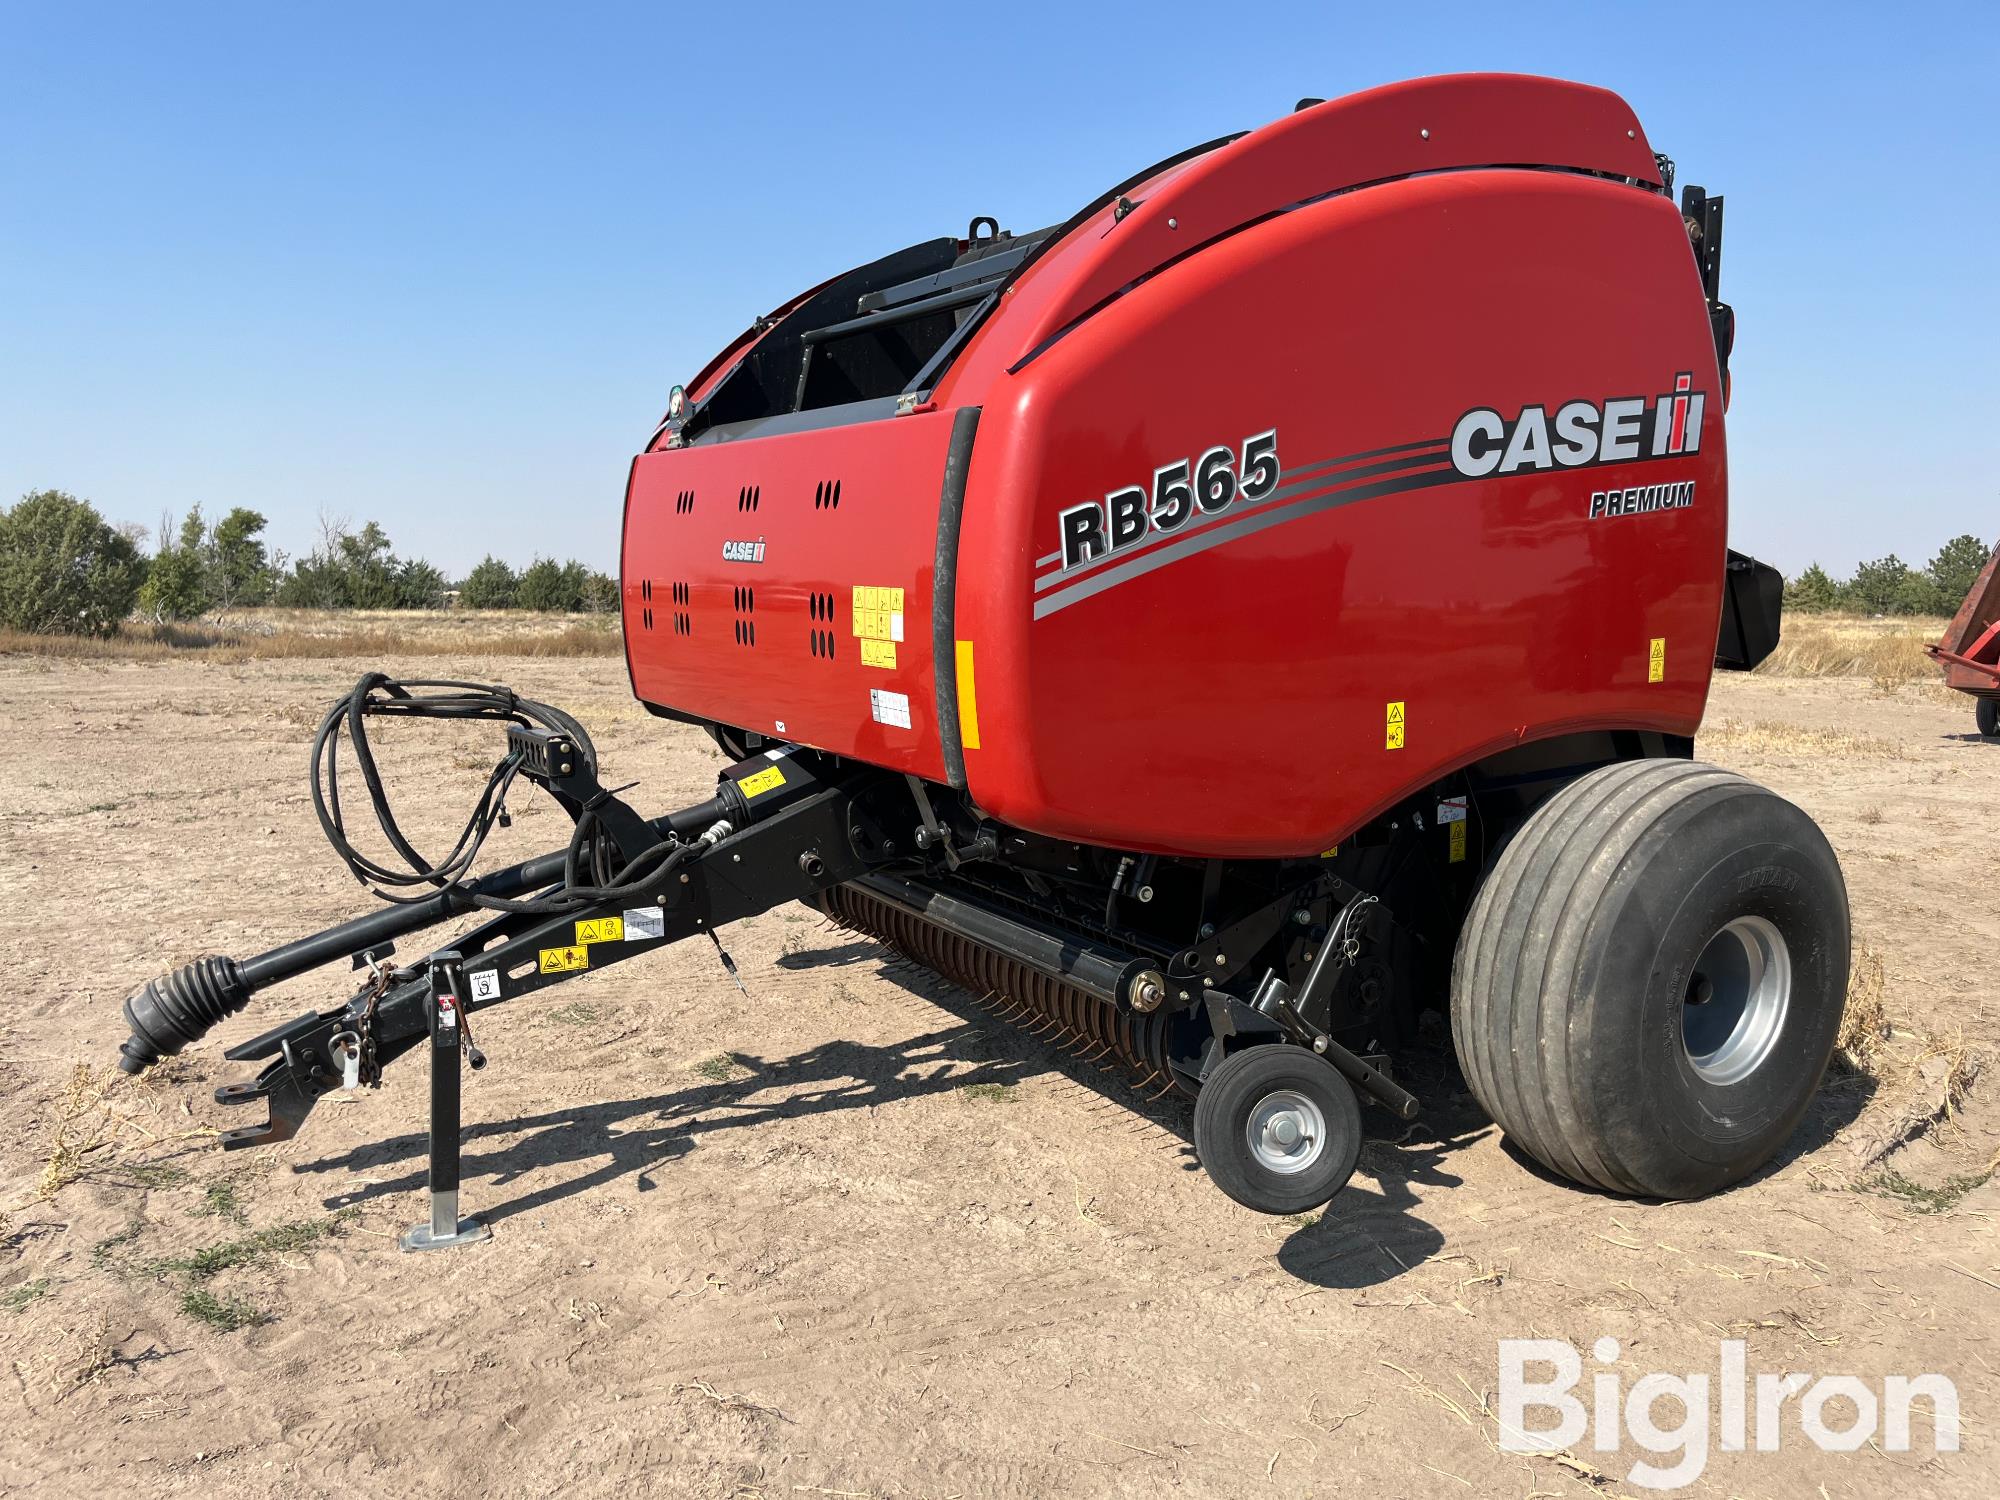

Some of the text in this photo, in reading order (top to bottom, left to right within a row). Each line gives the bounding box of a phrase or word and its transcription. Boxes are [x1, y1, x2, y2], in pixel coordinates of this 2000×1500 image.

[1452, 401, 1645, 477] CASE
[1059, 428, 1280, 573] RB565
[1589, 481, 1695, 519] PREMIUM
[723, 541, 754, 561] CASE
[1737, 867, 1801, 893] TITAN
